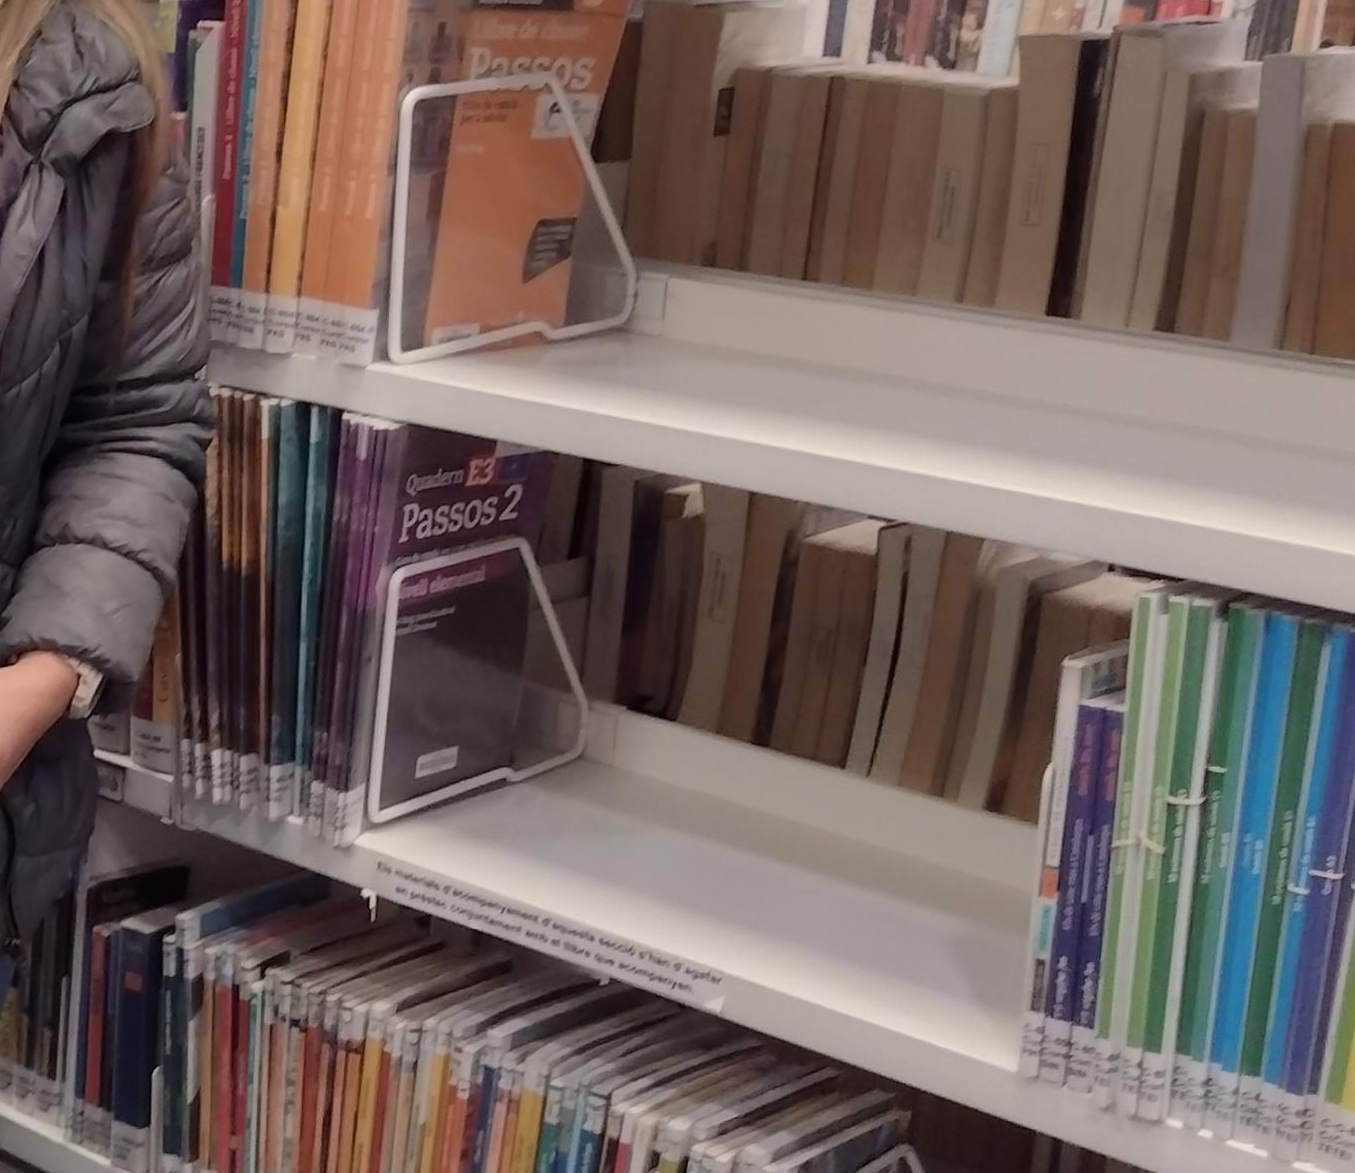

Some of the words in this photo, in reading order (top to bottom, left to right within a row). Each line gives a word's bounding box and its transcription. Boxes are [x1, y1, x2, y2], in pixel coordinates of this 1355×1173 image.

[470, 47, 597, 90] Passos
[406, 466, 464, 497] Quadern
[465, 457, 496, 487] E3
[398, 495, 498, 544] Passos
[499, 484, 524, 521] 2
